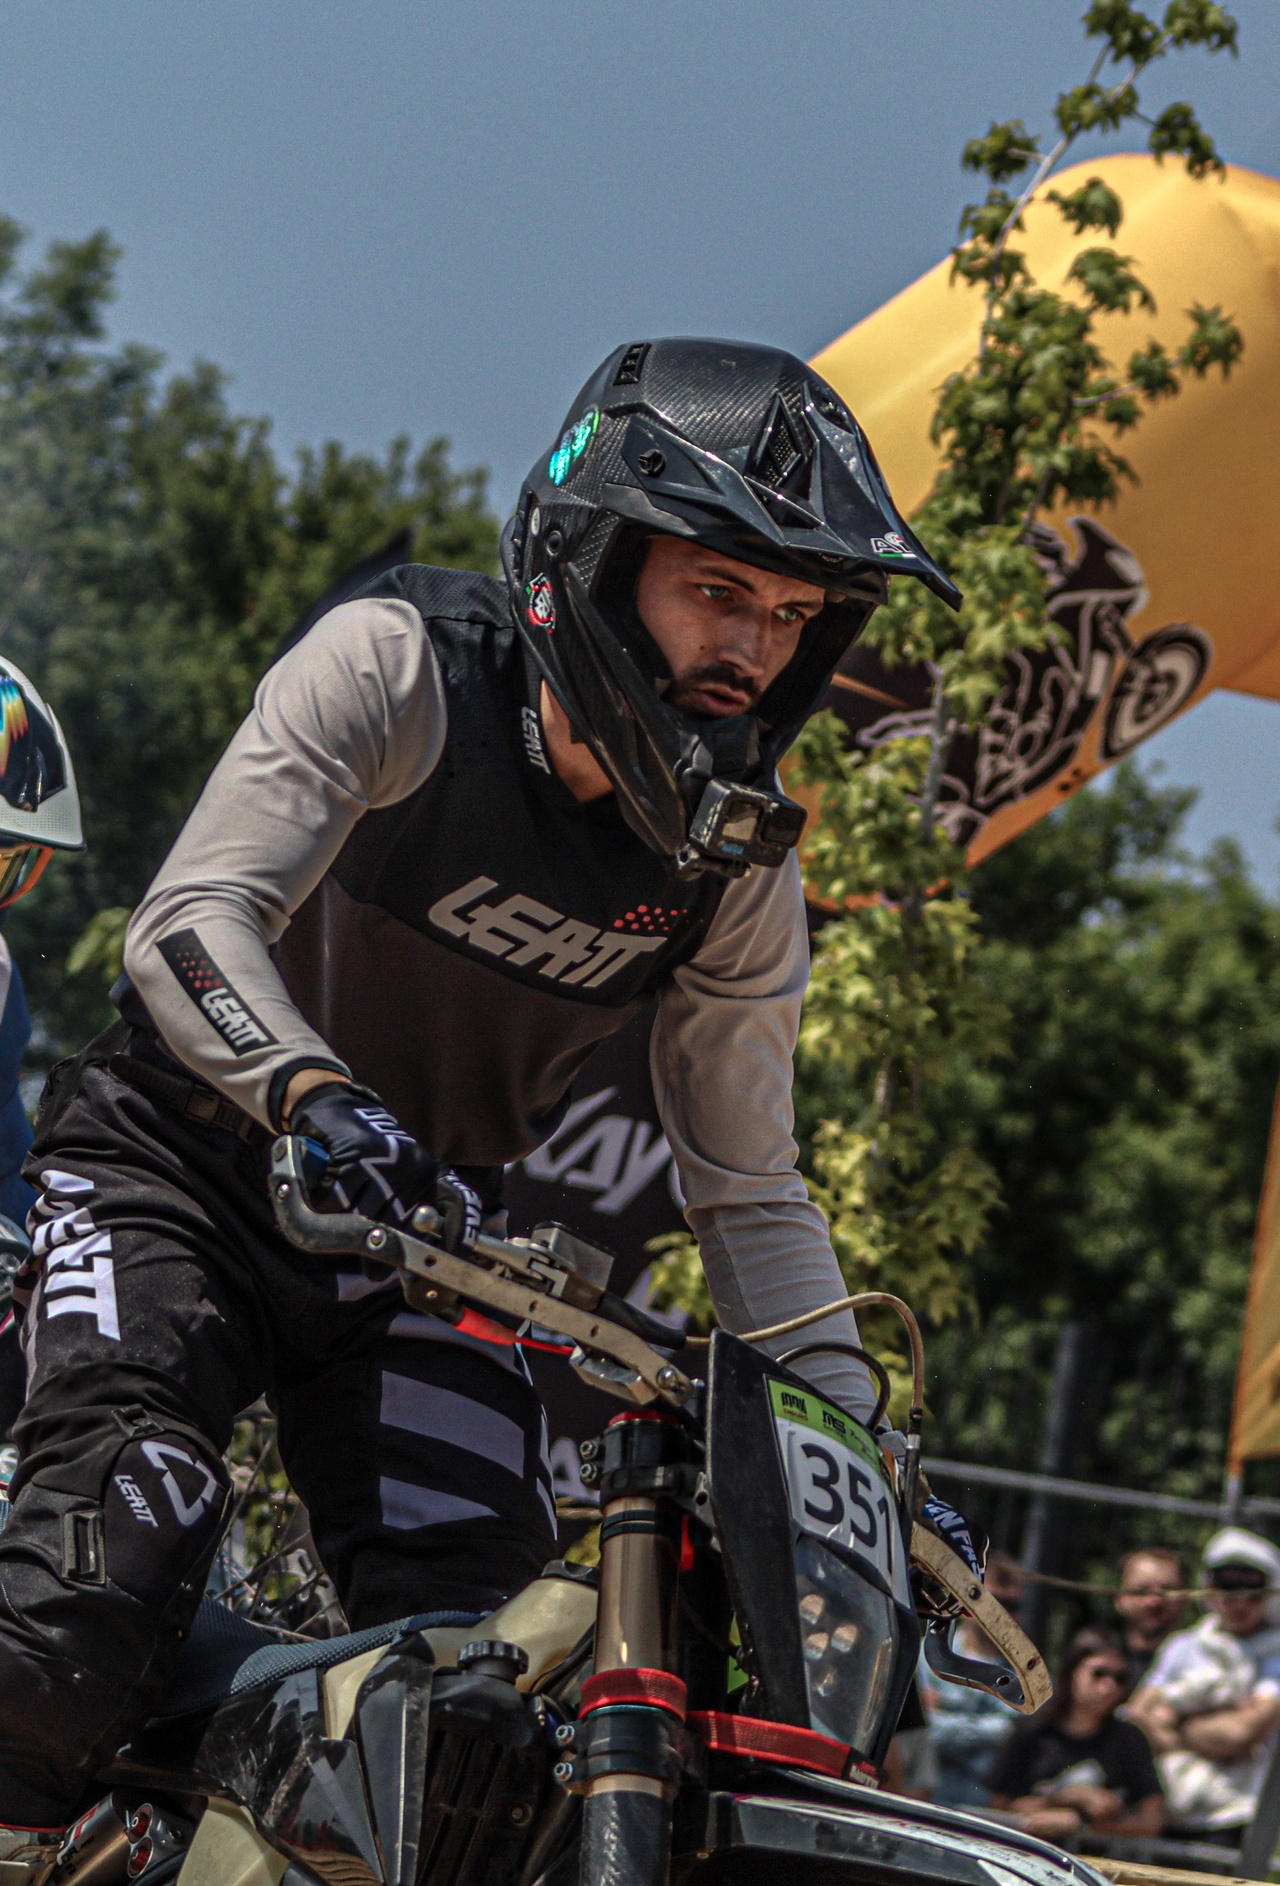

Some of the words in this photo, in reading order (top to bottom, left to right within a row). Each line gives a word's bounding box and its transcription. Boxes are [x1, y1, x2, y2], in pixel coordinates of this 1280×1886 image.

[521, 706, 551, 774] LEATT
[428, 875, 668, 988] LEATT
[200, 987, 270, 1048] LEATT
[114, 1474, 159, 1528] LEATT
[801, 1442, 893, 1576] 351
